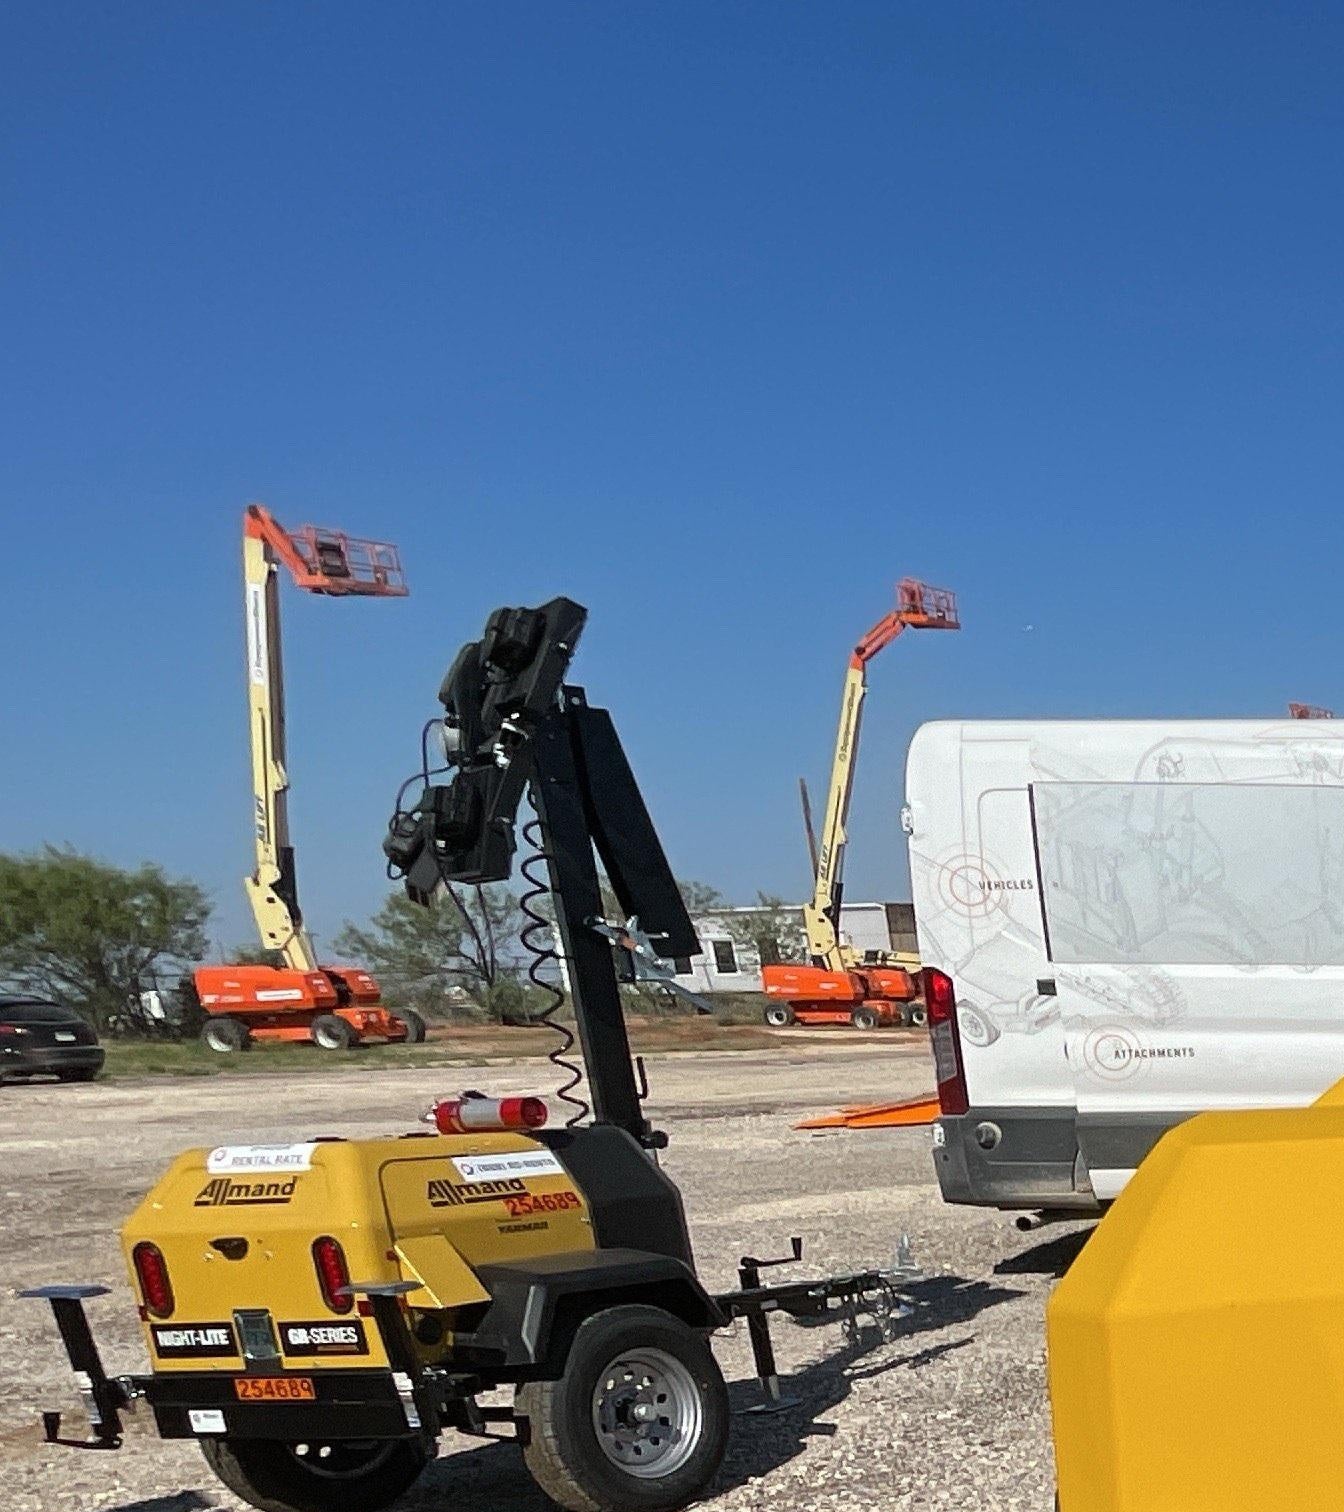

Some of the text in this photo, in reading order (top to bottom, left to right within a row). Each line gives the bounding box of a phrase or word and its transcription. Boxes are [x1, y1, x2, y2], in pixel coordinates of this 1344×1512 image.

[978, 878, 1034, 891] VEHICLES
[1114, 1047, 1195, 1060] ATTACHMENTS
[193, 1175, 298, 1206] Allmand
[427, 1178, 528, 1206] Allmand
[505, 1191, 583, 1218] 254689
[156, 1328, 230, 1347] NIGHT-LITE
[237, 1379, 314, 1399] 254689
